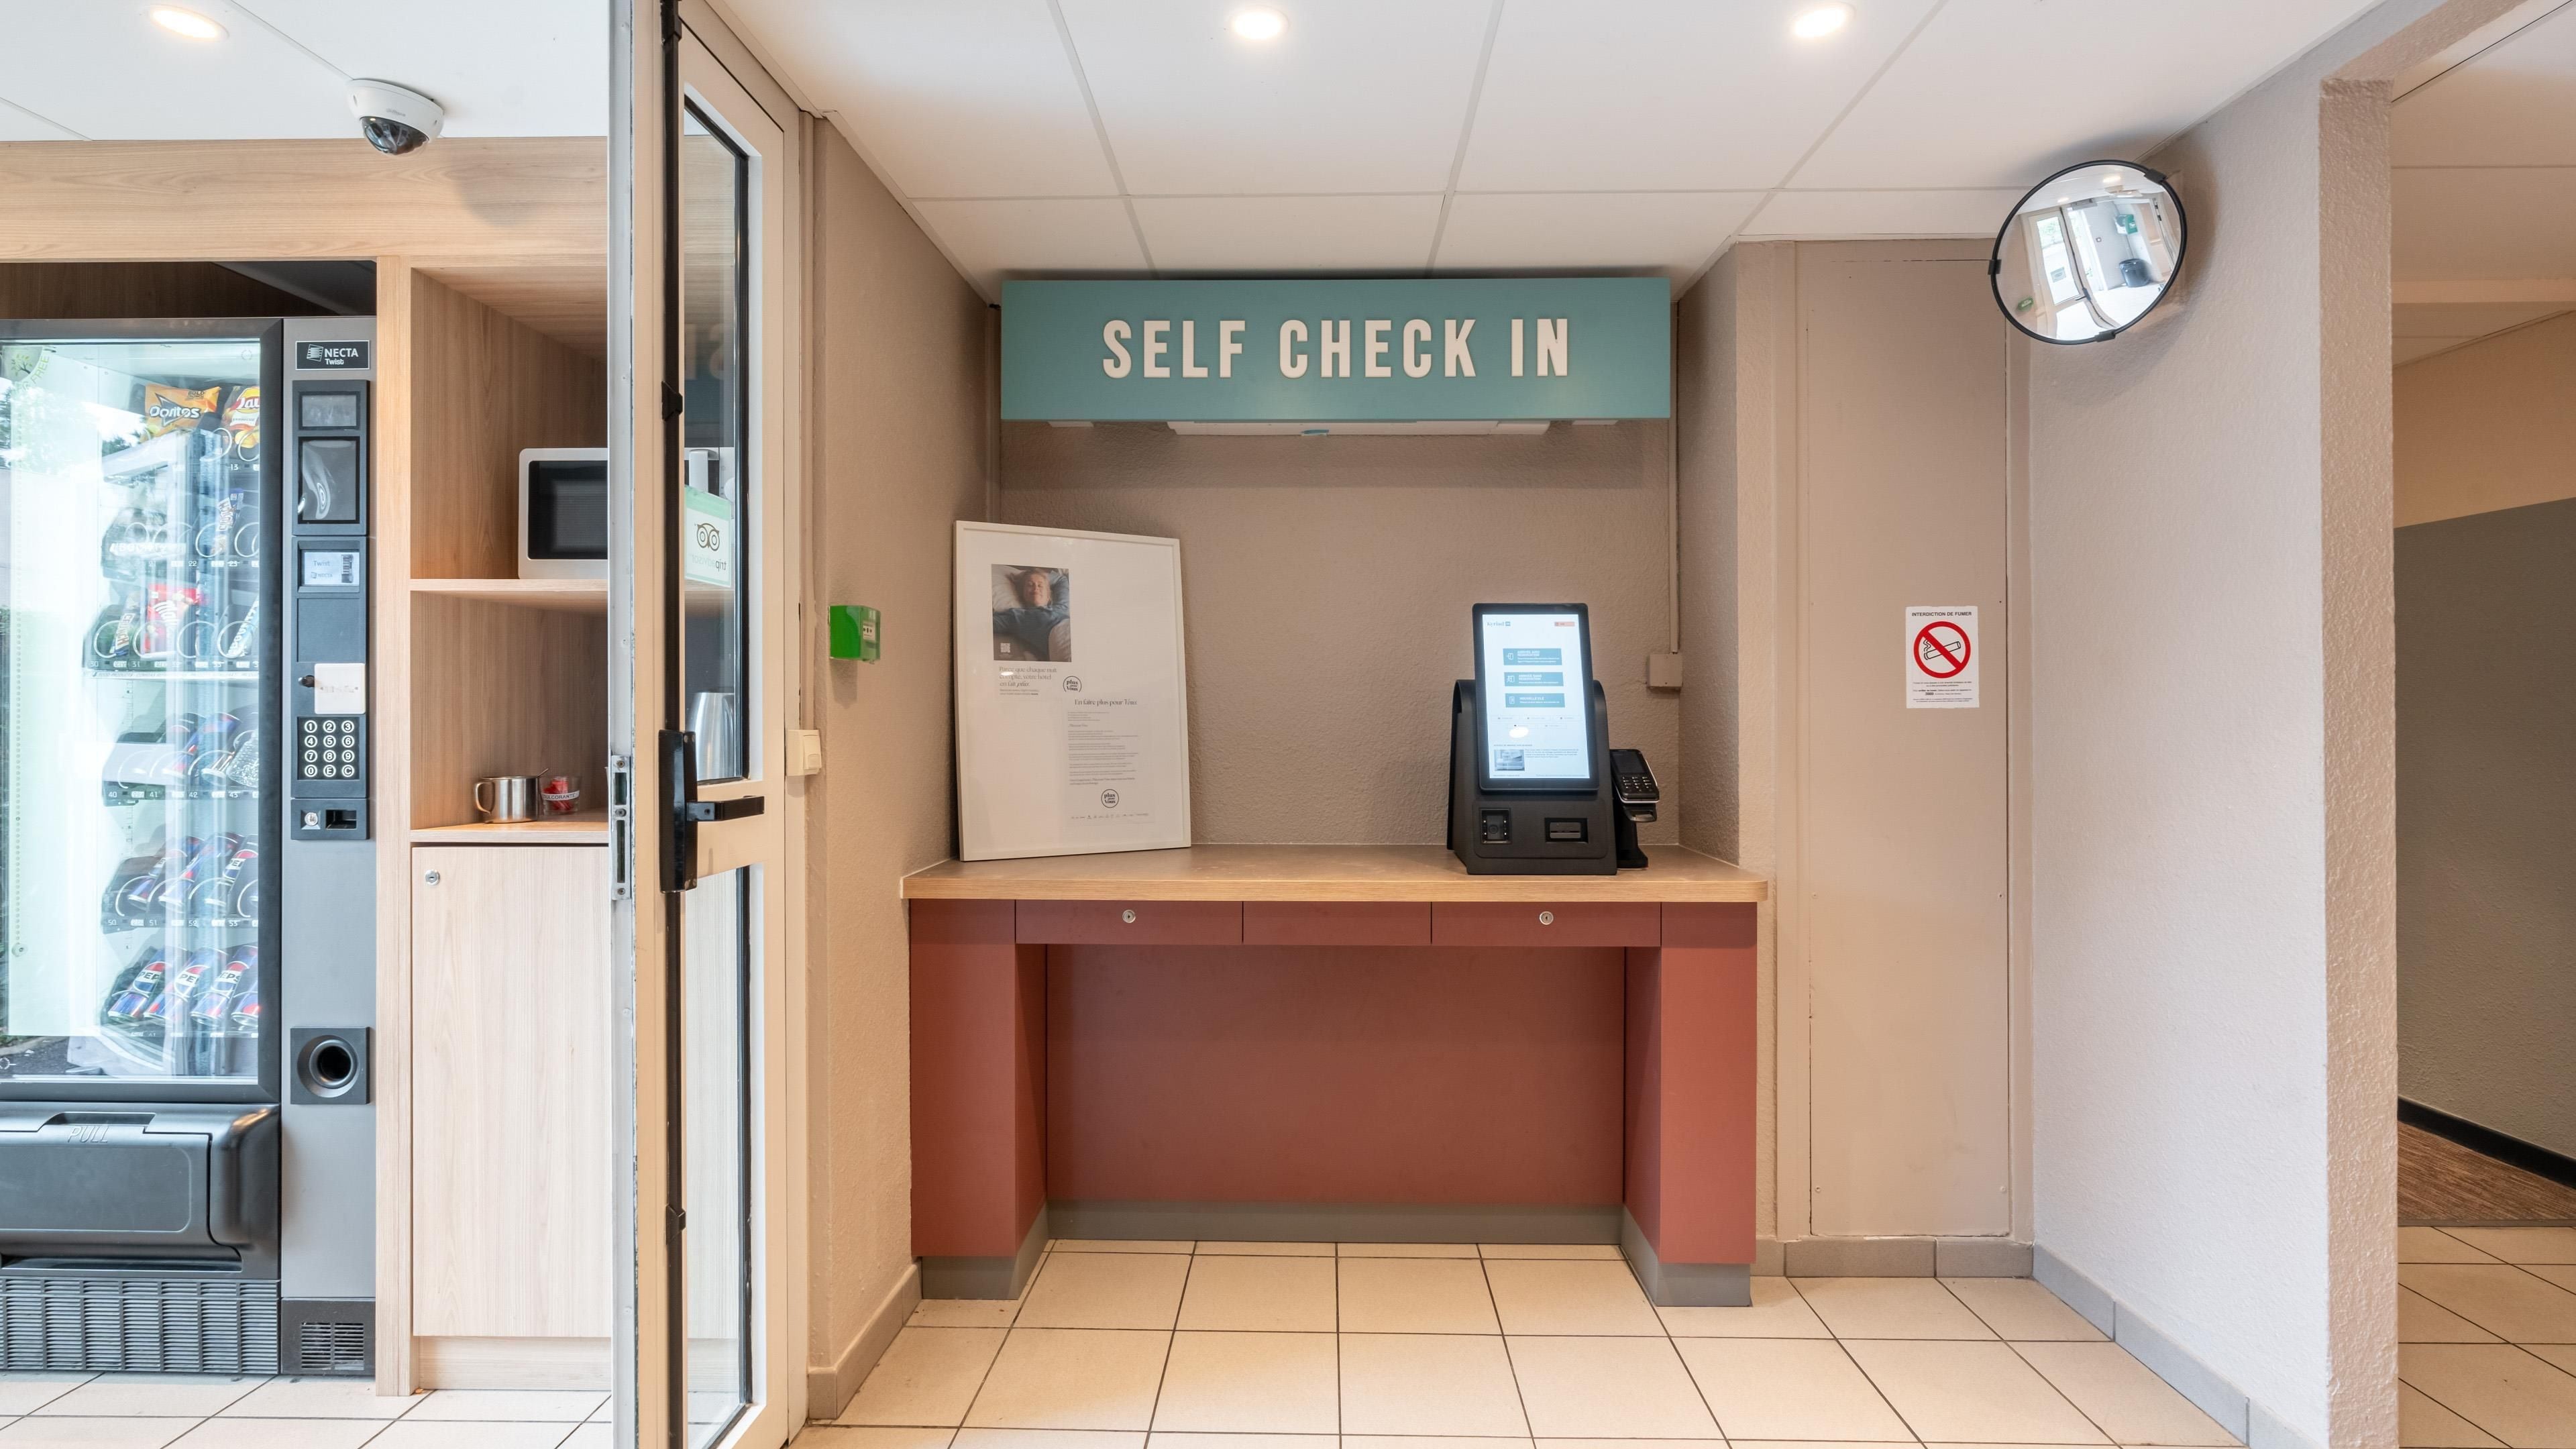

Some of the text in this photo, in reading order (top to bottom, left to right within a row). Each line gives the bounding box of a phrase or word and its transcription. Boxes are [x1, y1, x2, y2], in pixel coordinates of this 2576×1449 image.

[324, 348, 359, 358] NECTA
[1102, 318, 1568, 379] SELF CHECK IN
[150, 405, 201, 419] Doritos
[1026, 666, 1046, 674] chaque
[68, 1126, 109, 1143] PULL
